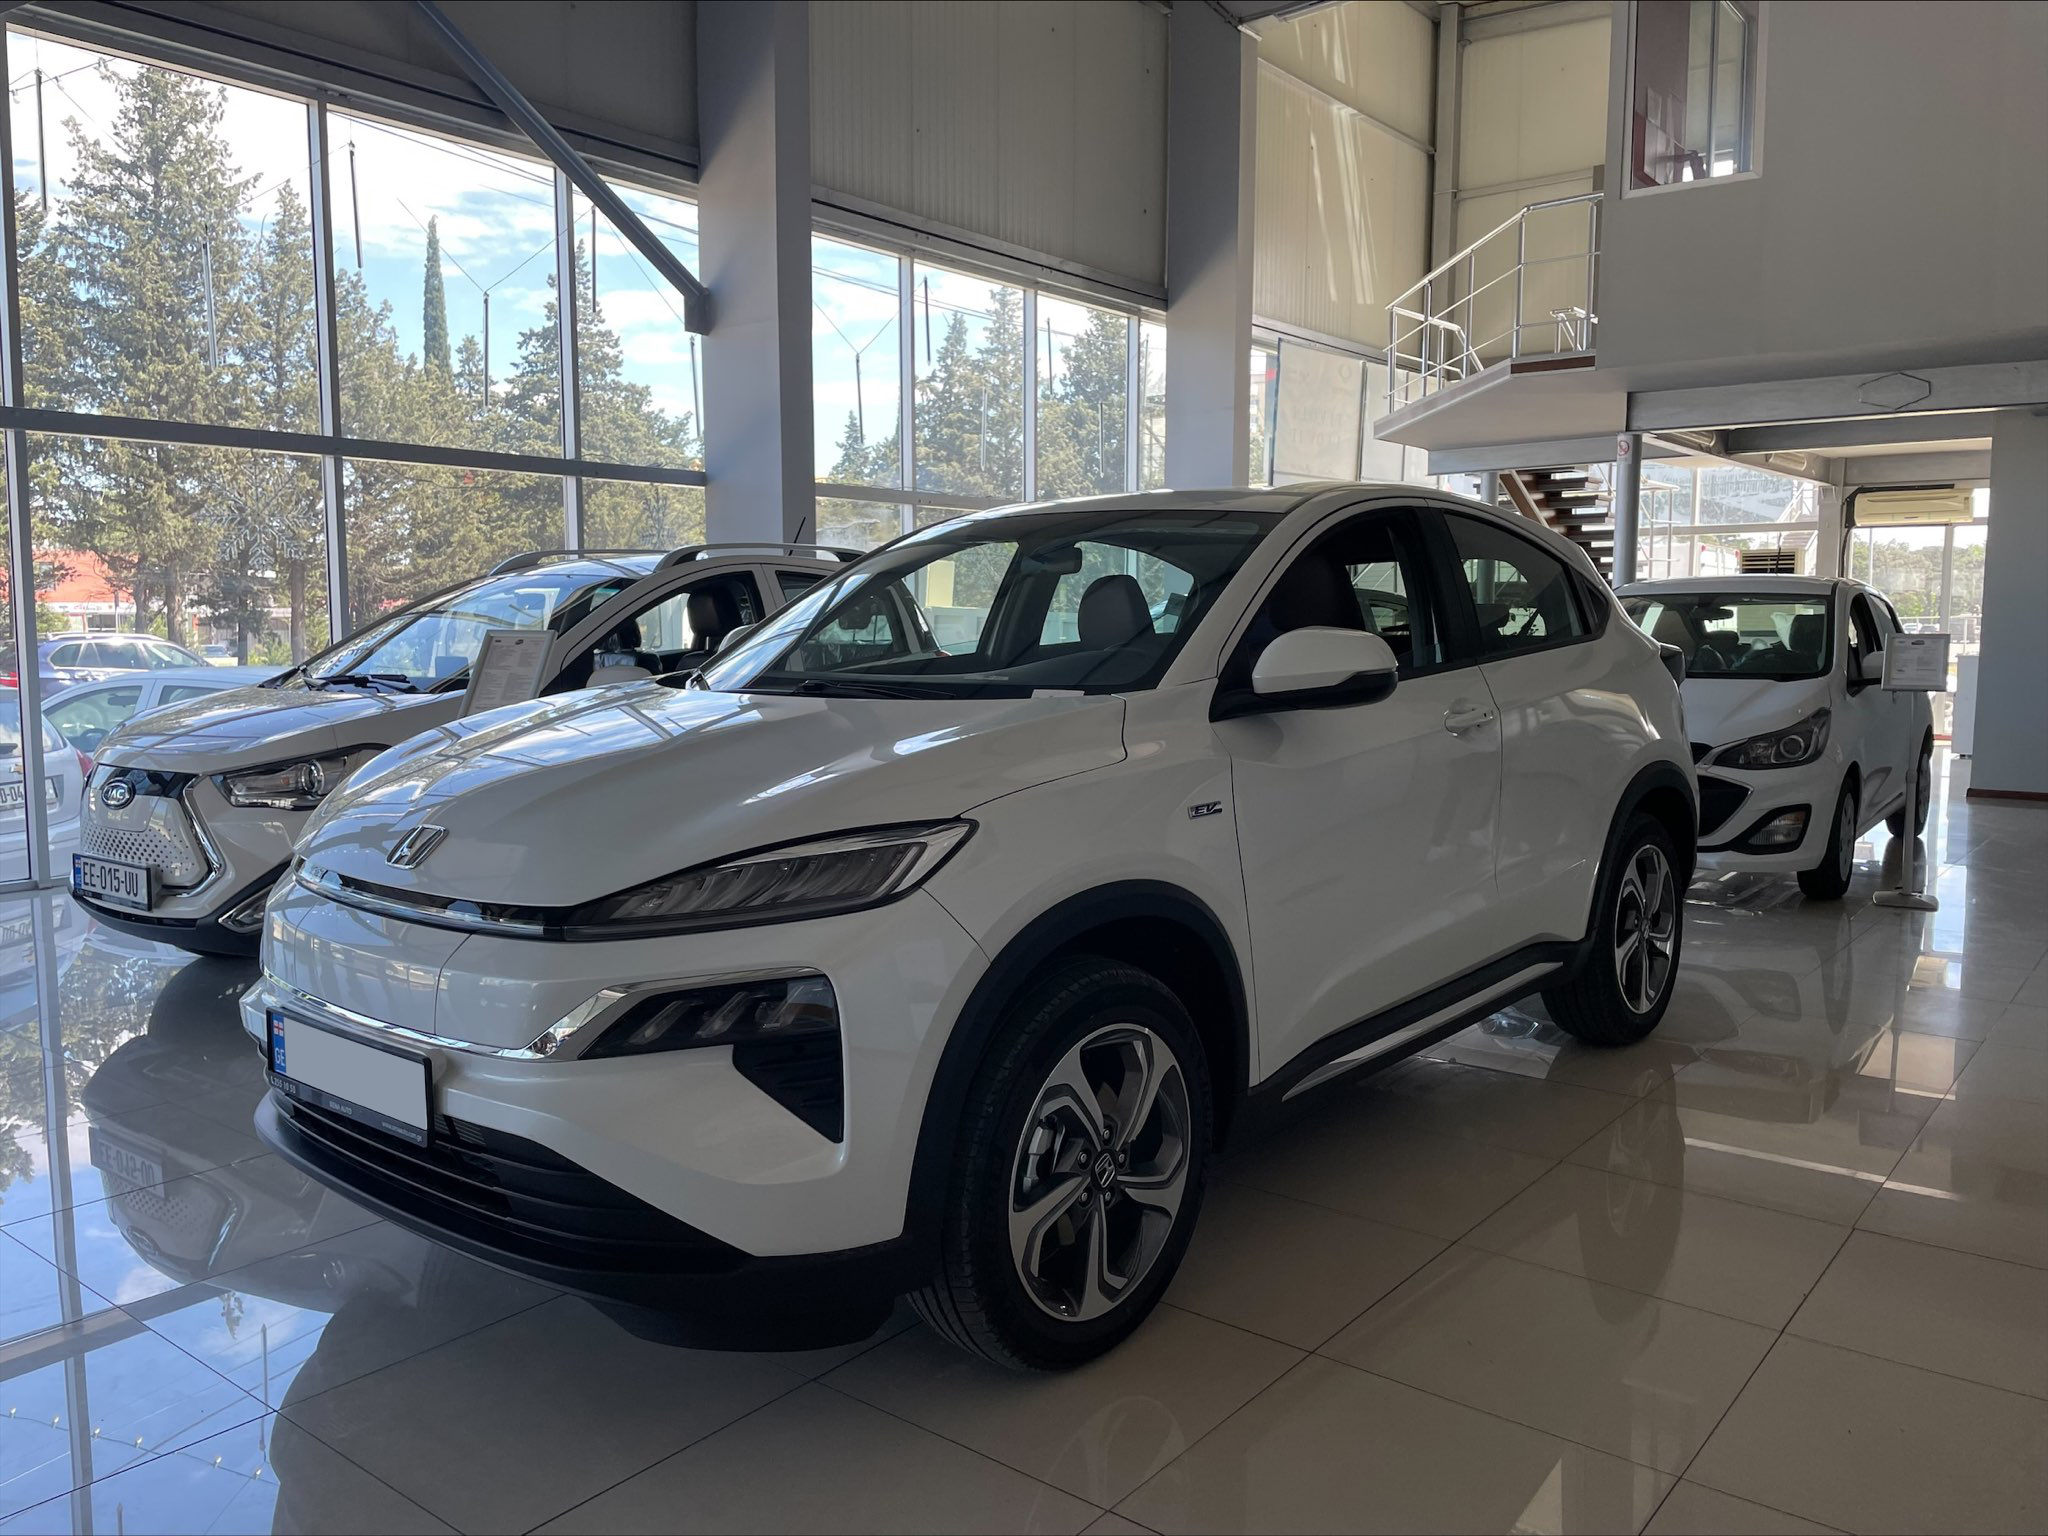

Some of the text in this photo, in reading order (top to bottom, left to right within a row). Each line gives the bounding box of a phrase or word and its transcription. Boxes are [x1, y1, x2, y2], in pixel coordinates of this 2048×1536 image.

[1190, 801, 1222, 817] EV
[83, 861, 139, 898] EE-015-UU
[275, 1047, 286, 1067] GE
